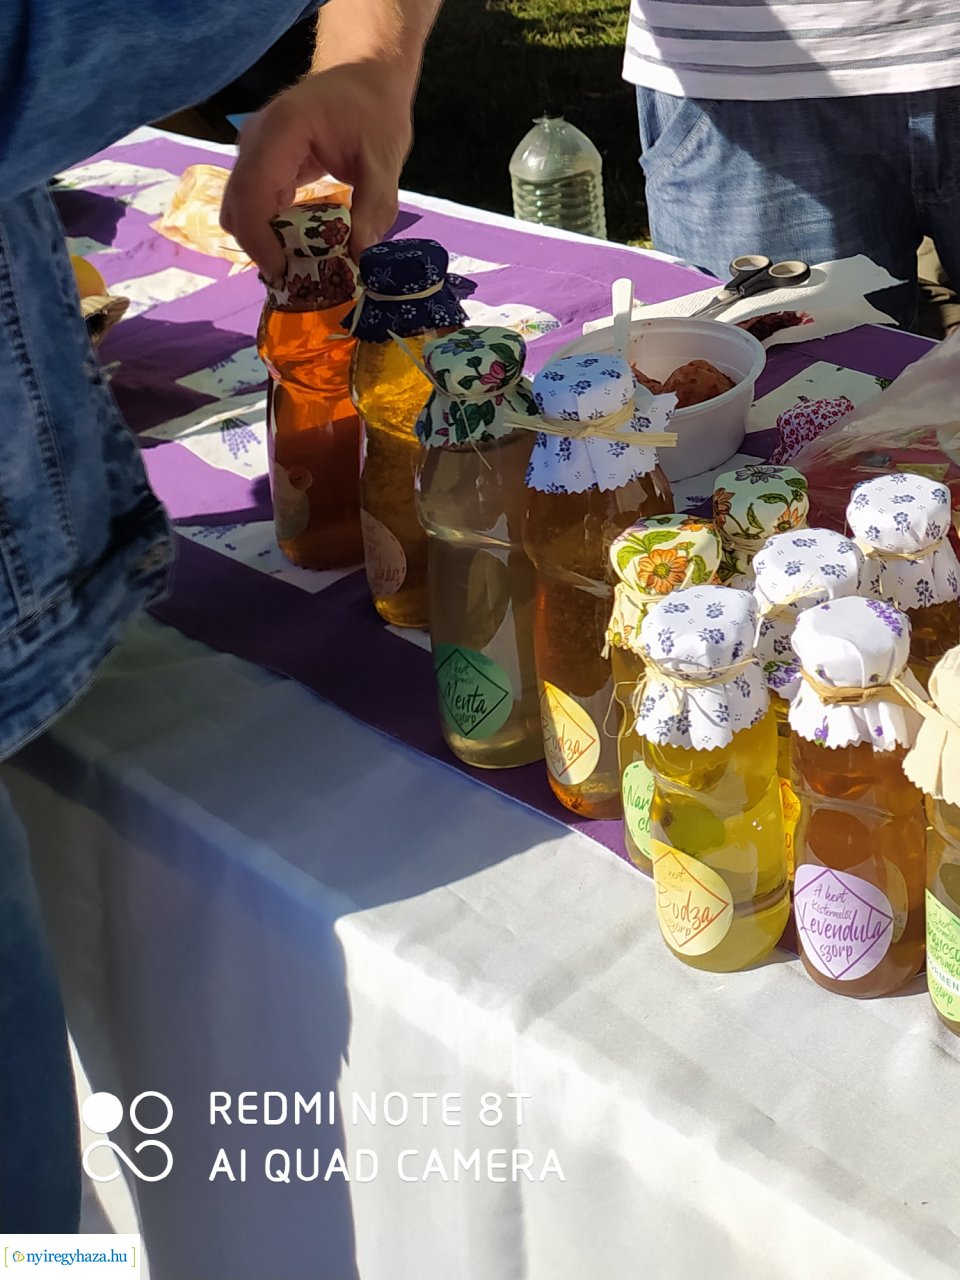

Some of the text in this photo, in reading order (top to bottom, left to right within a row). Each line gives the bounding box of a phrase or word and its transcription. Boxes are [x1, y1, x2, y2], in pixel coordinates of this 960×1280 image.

[444, 680, 487, 715] Menta
[656, 881, 714, 930] Bodza
[800, 903, 882, 943] Levendula
